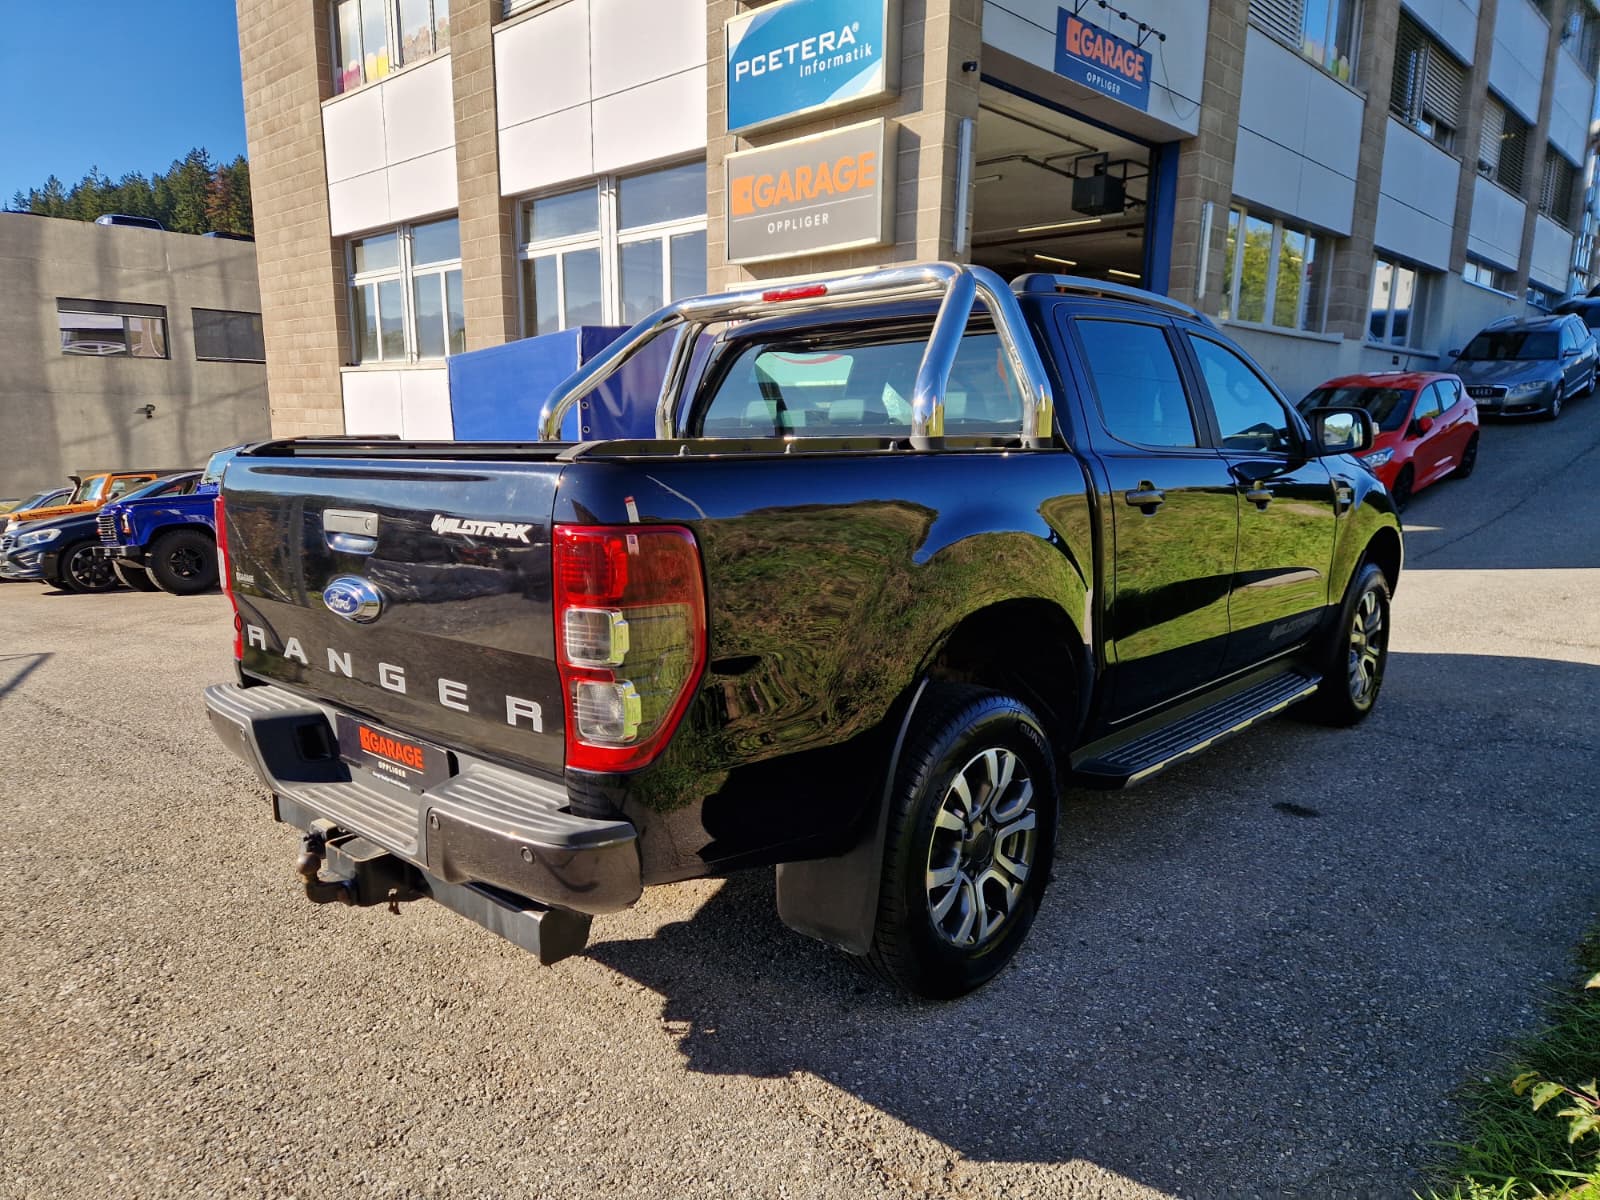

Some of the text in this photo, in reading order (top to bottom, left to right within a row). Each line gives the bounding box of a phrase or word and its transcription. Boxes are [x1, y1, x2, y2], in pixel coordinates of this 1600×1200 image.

[799, 43, 873, 78] Informatik
[1080, 27, 1145, 83] GARAGE
[1086, 71, 1121, 95] OPPLIGER
[753, 151, 877, 209] GARAGE
[767, 212, 830, 235] OPPLIGER
[430, 513, 534, 544] WILDTRAK
[329, 589, 351, 611] Ford
[246, 623, 544, 734] RANGER
[368, 731, 425, 770] GARAGE
